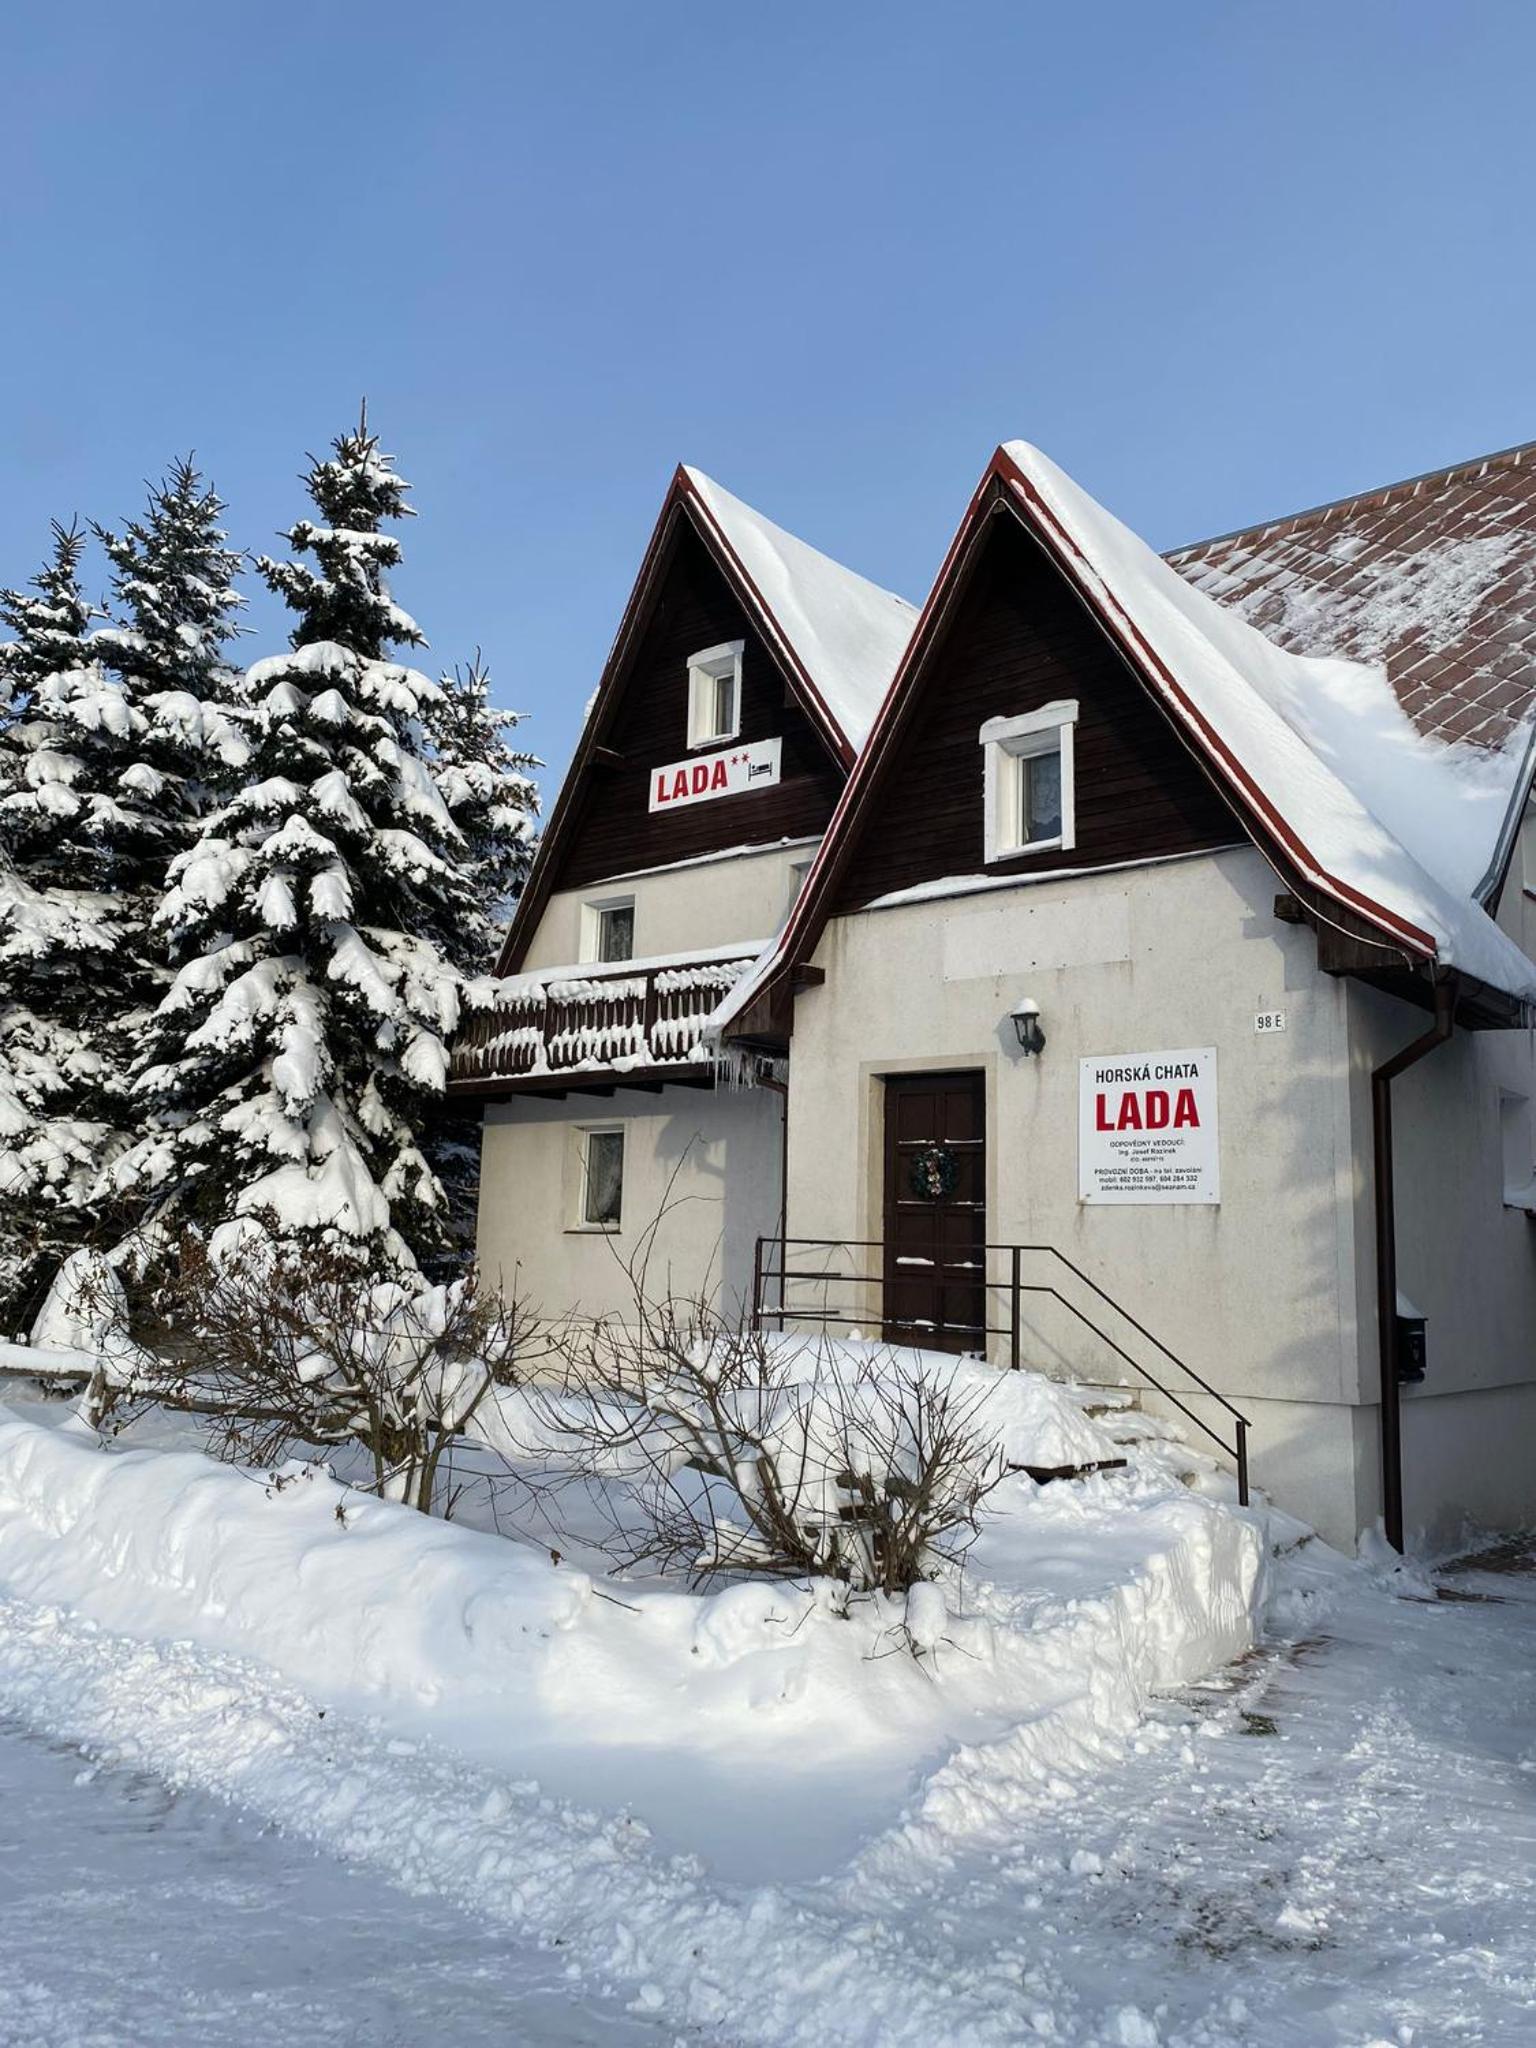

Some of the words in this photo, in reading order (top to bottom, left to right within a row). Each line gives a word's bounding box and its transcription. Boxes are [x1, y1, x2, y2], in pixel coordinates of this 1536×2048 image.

[657, 759, 728, 803] LADA
[1258, 1015, 1272, 1029] 98
[1275, 1014, 1282, 1028] E
[1096, 1063, 1151, 1083] HORSKÁ
[1155, 1063, 1199, 1080] CHATA
[1096, 1088, 1200, 1131] LADA
[1129, 1167, 1149, 1175] DOBA
